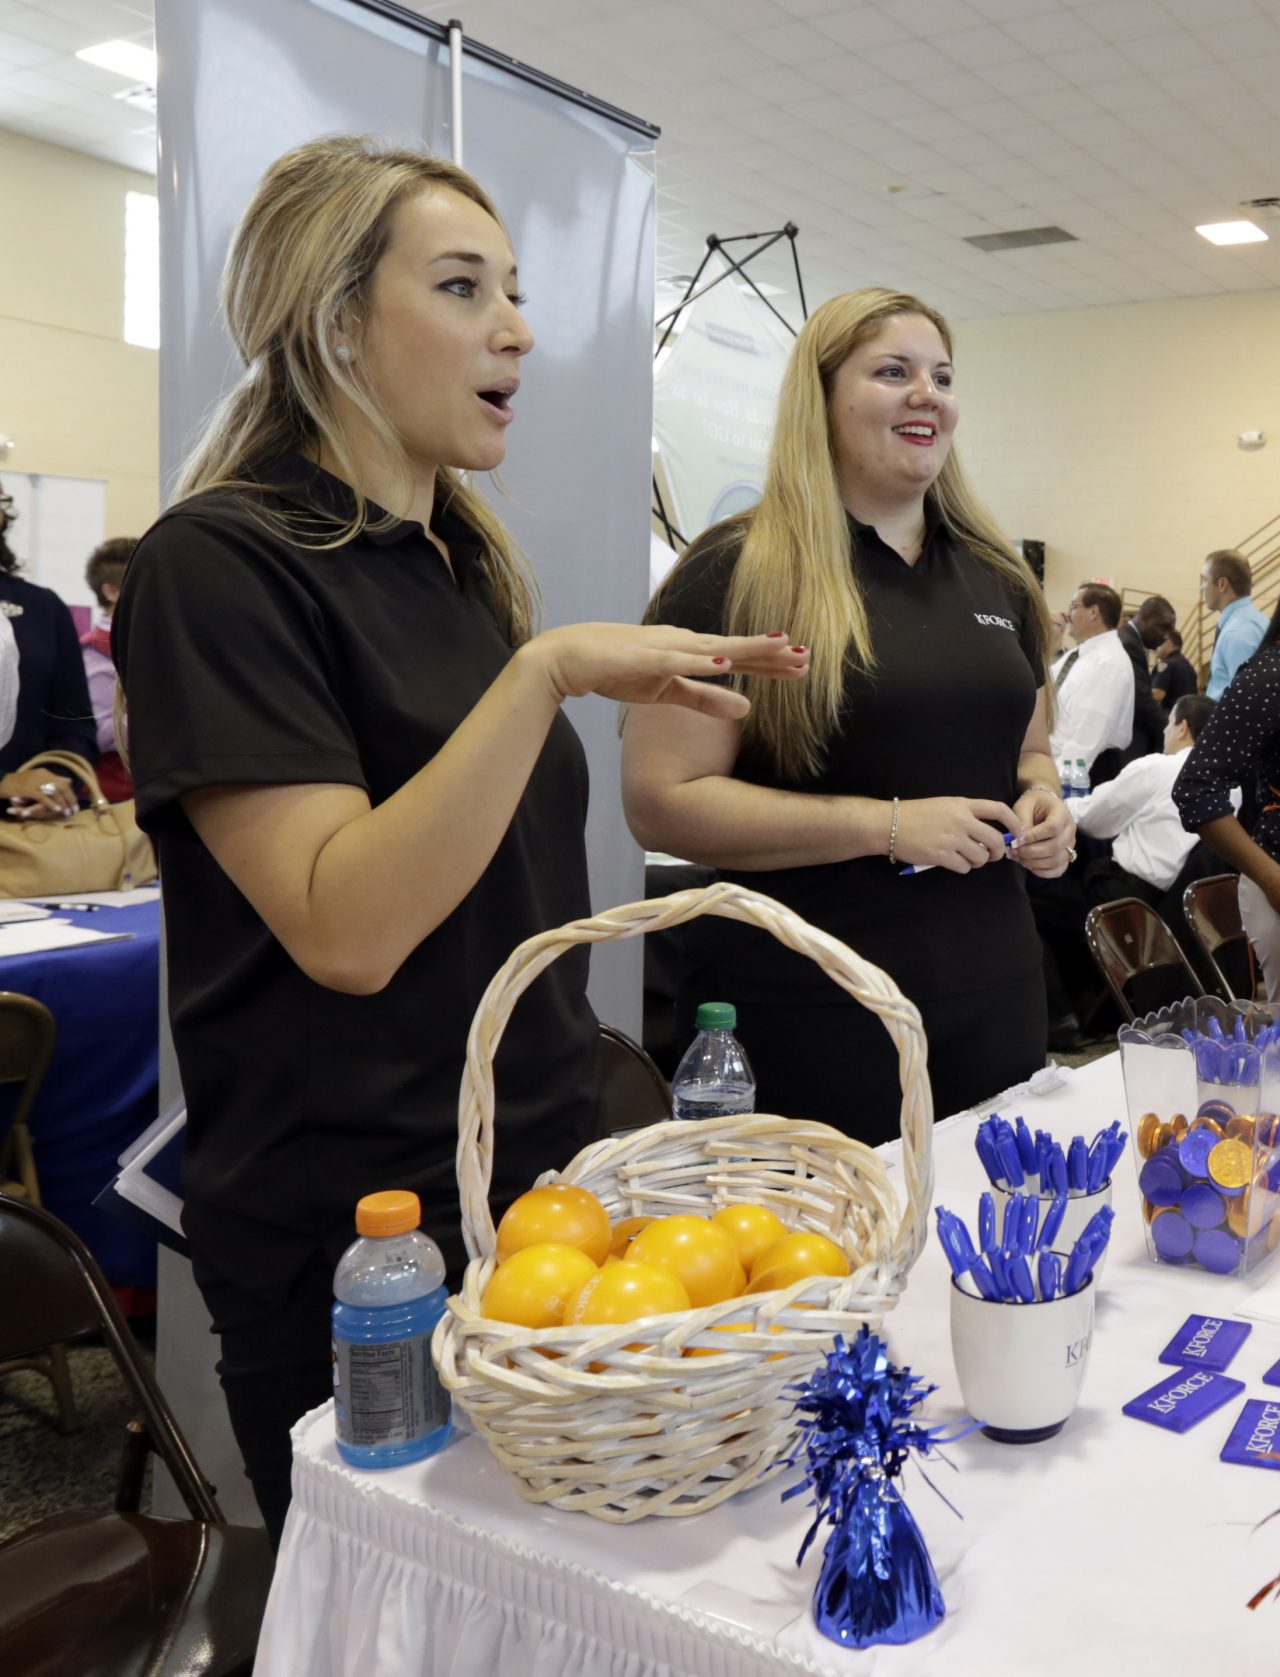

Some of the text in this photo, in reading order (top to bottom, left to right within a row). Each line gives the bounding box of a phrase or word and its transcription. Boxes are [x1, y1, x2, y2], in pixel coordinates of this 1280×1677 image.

[974, 613, 1015, 631] KFORCE
[1182, 1318, 1224, 1358] KFORCE
[1147, 1371, 1214, 1414] KFORCE
